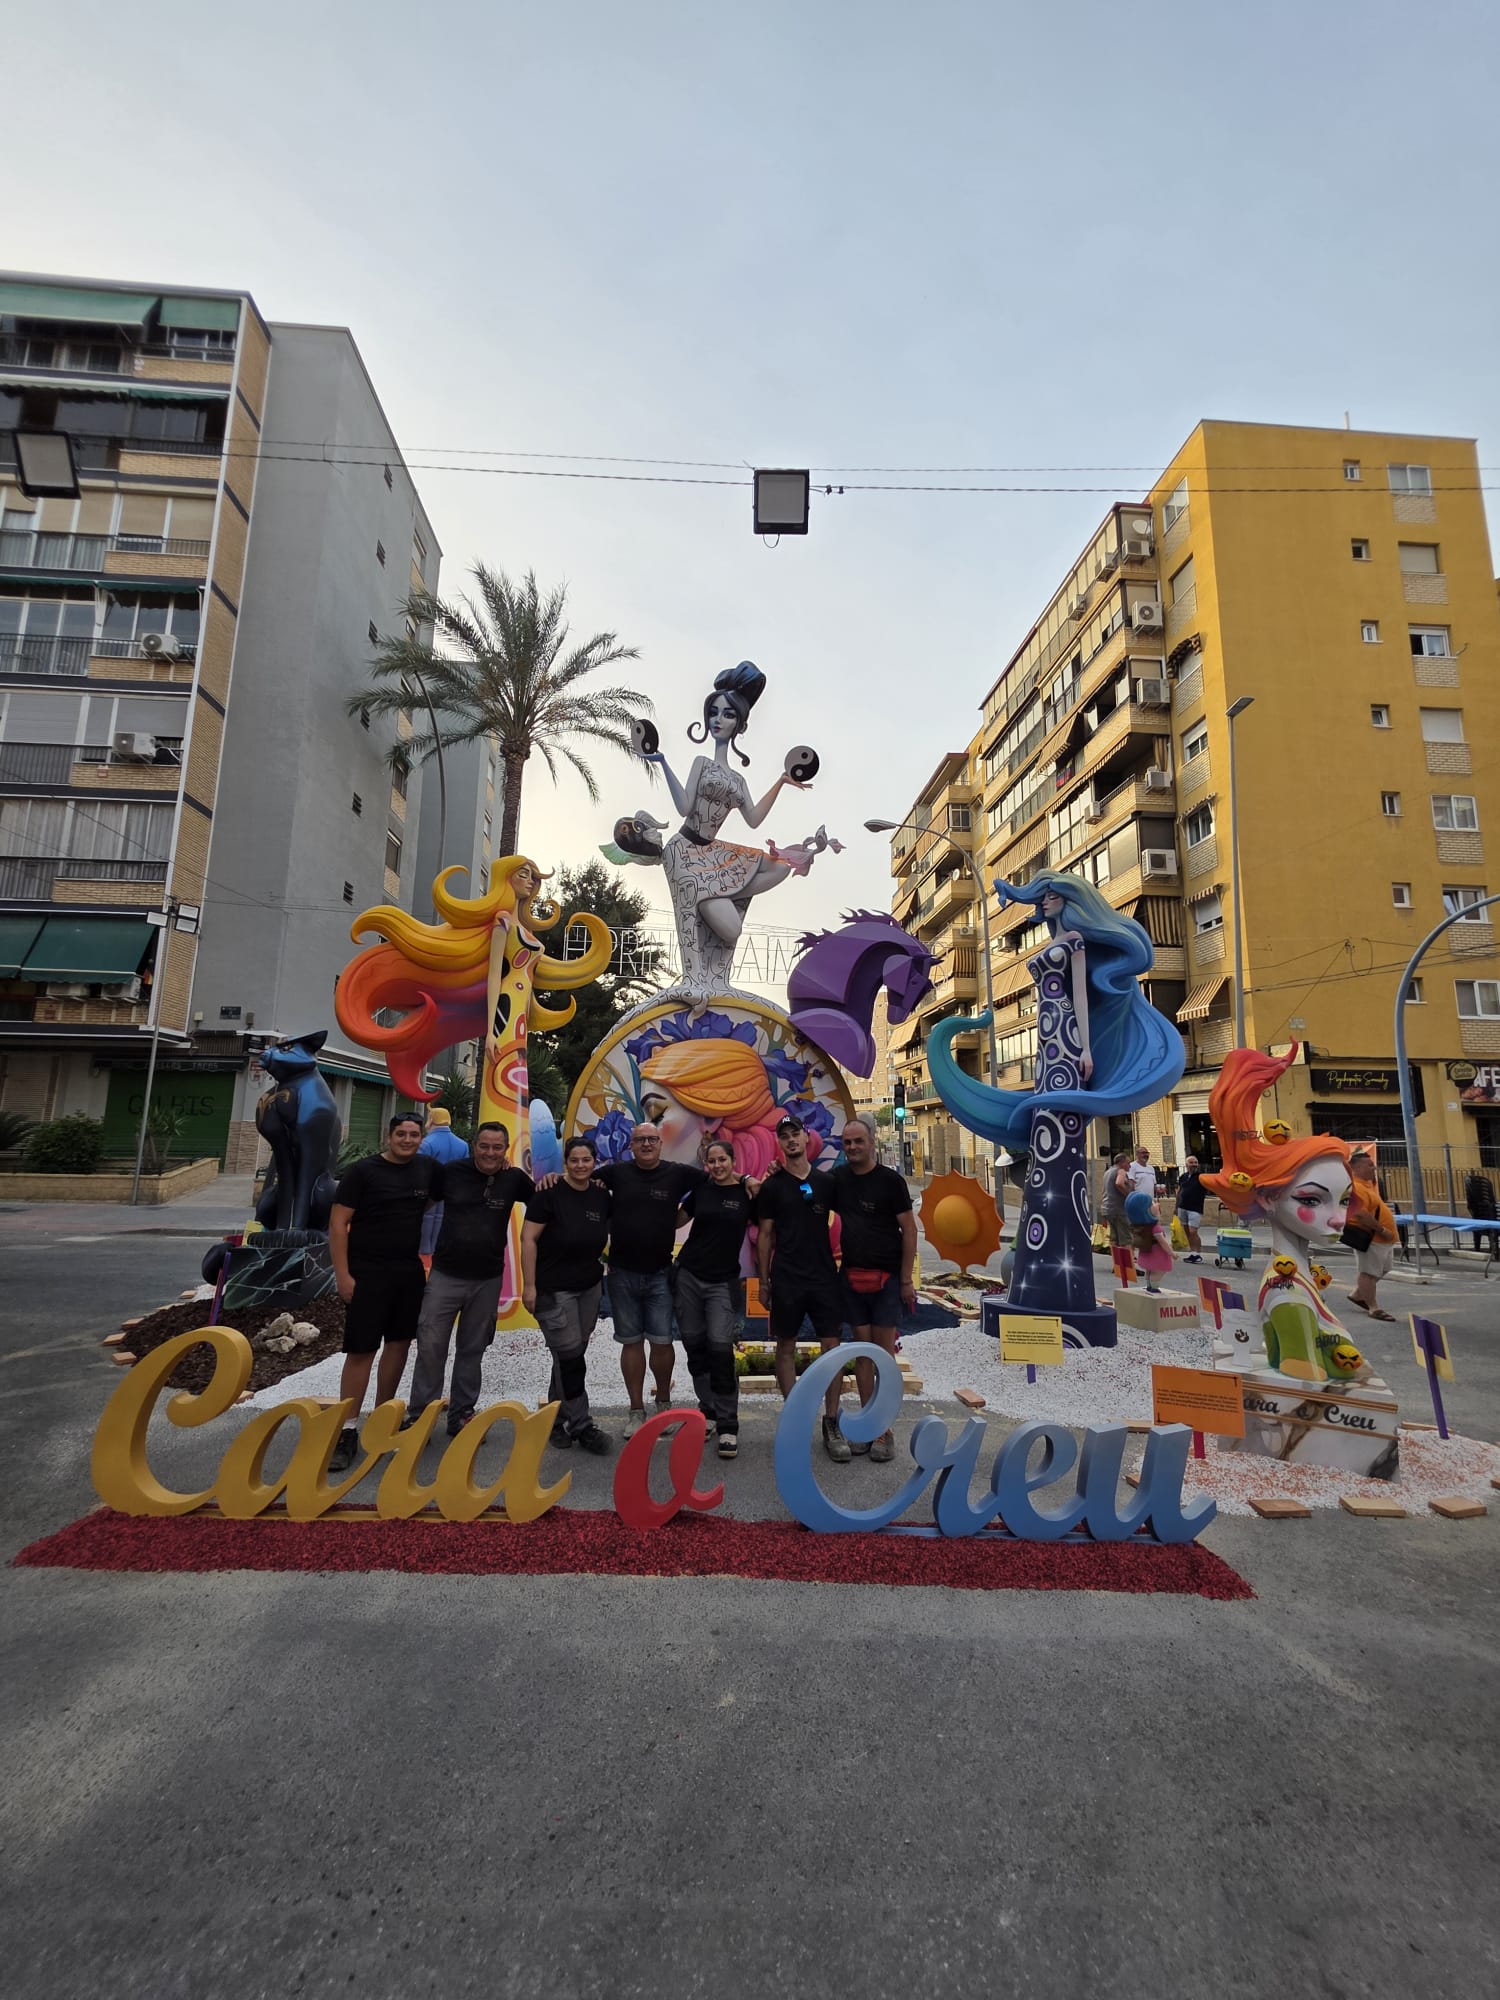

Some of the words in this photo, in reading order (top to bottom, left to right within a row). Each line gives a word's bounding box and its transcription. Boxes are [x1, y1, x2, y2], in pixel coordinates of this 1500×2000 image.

[1474, 1067, 1500, 1088] AFE
[1159, 1305, 1197, 1318] MILAN
[1244, 1399, 1280, 1414] ara
[1324, 1404, 1376, 1430] Creu
[91, 1326, 572, 1523] Cara
[774, 1341, 1216, 1543] Creu
